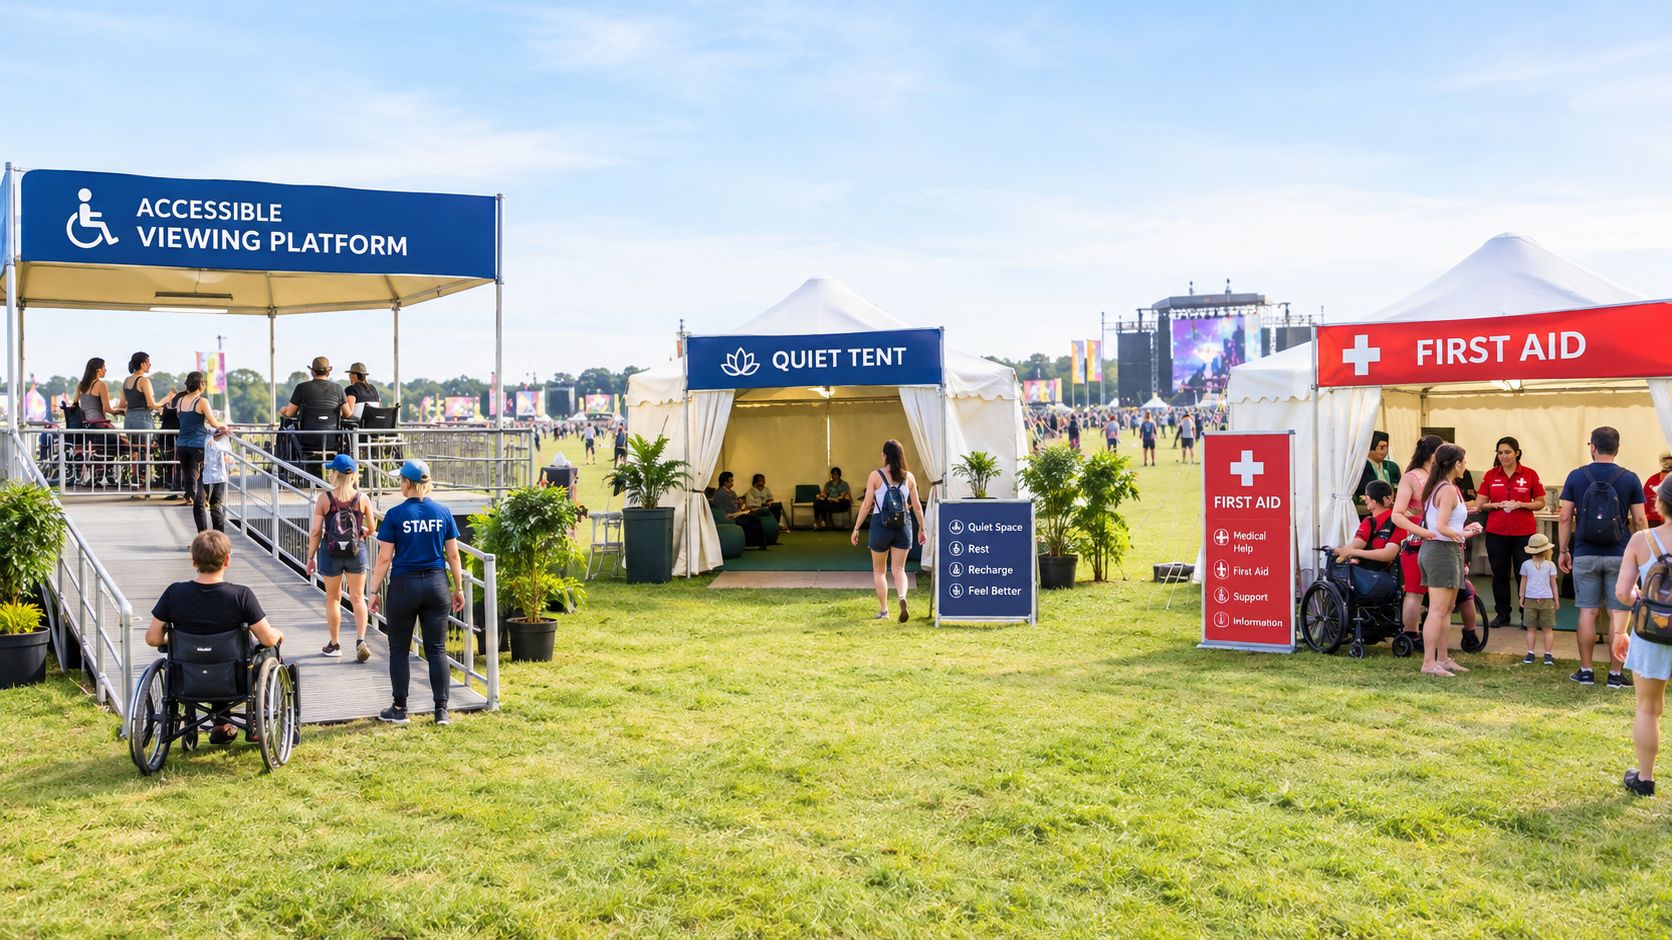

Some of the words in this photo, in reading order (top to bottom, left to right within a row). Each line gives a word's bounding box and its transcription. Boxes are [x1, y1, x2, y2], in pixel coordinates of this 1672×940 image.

[136, 197, 282, 223] ACCESSIBLE
[136, 225, 261, 251] VIEWING
[270, 231, 408, 256] PLATFORM
[1416, 334, 1511, 365] FIRST
[1519, 330, 1587, 361] AID
[772, 349, 842, 372] QUIET
[847, 346, 907, 367] TENT
[1214, 495, 1253, 509] FIRST
[1255, 495, 1281, 509] AID
[402, 519, 443, 533] STAFF
[968, 522, 993, 533] Quiet
[995, 522, 1023, 533] Space
[1233, 531, 1266, 541] Medical
[968, 544, 990, 554] Rest
[1233, 544, 1254, 555] Help
[968, 565, 1013, 576] Recharge
[1233, 566, 1252, 576] First
[1254, 566, 1269, 576] Aid
[968, 586, 989, 596] Feel
[991, 586, 1022, 596] Better
[1233, 592, 1268, 603] Support
[1233, 617, 1283, 627] Information
